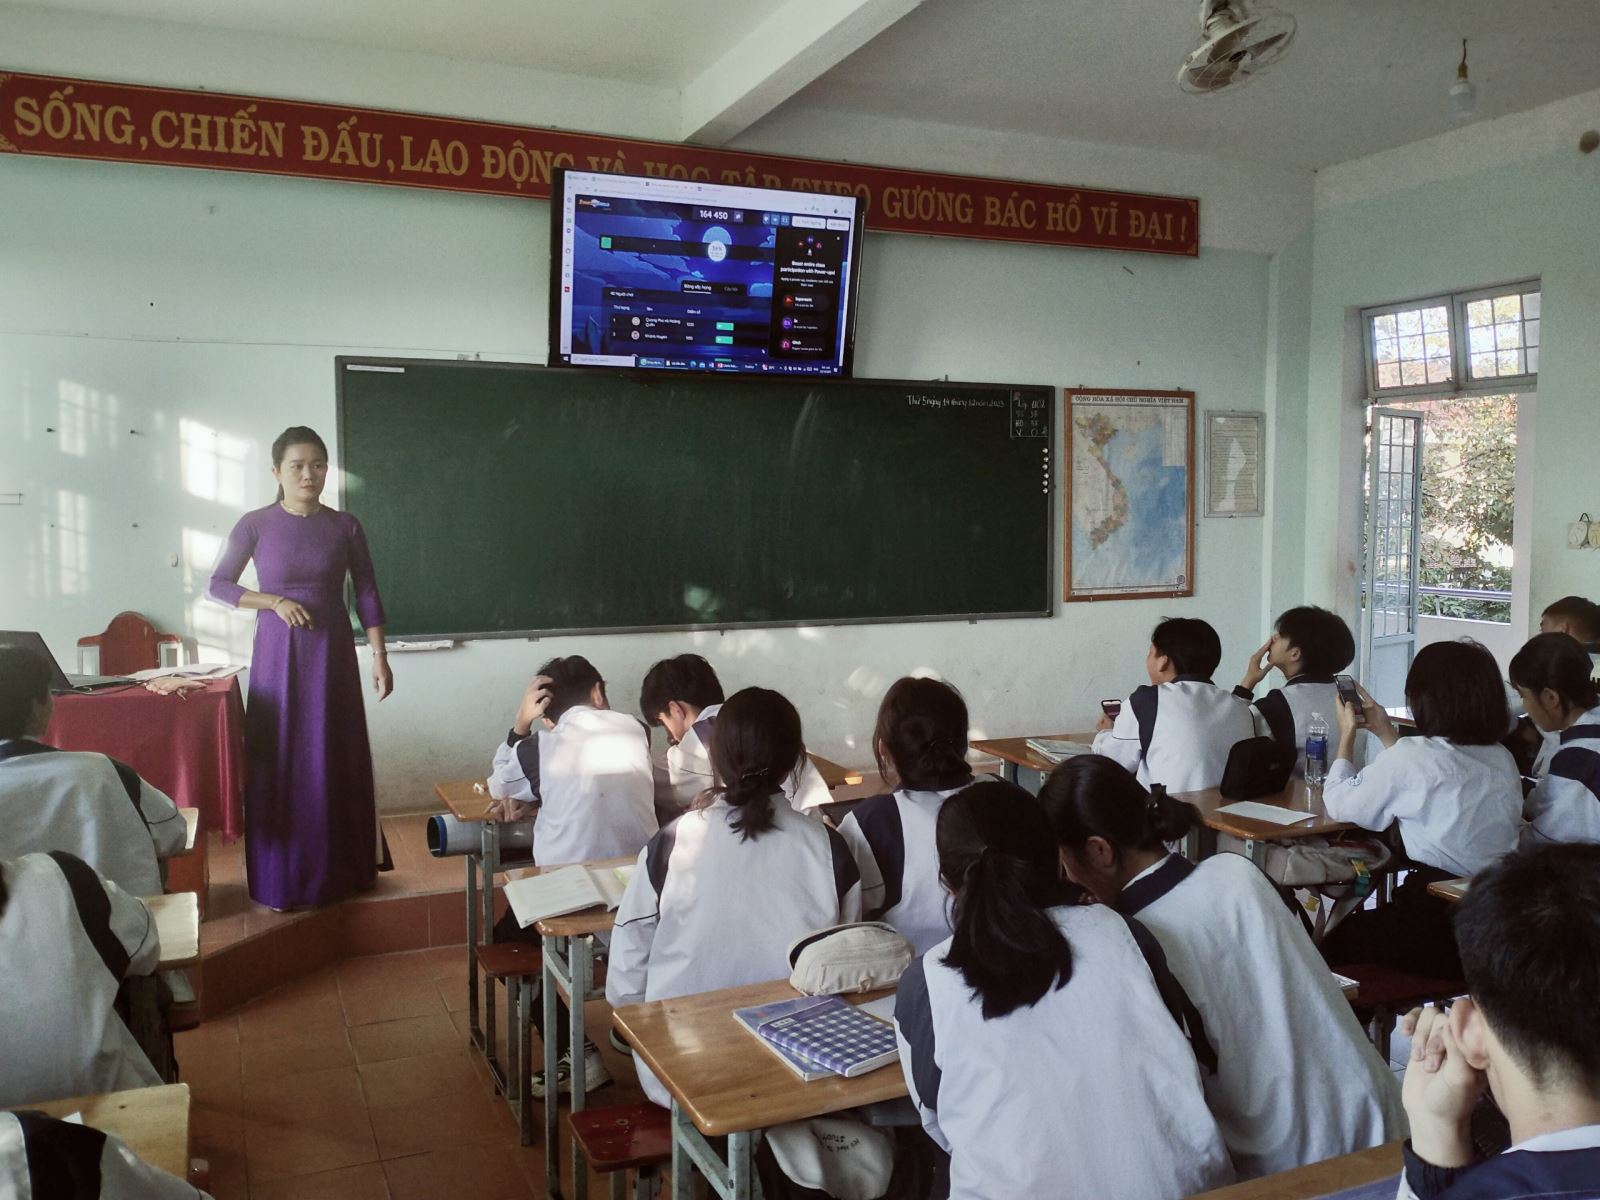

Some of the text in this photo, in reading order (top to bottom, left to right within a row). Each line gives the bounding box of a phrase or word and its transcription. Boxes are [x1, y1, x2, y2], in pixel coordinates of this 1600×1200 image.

[151, 104, 286, 158] CHIẾN
[400, 135, 469, 176] LAO
[881, 184, 974, 225] GƯƠNG
[983, 191, 1037, 229] BÁC
[1046, 193, 1083, 233] HỒ
[1090, 201, 1119, 237] VĨ
[699, 209, 729, 220] 164 450
